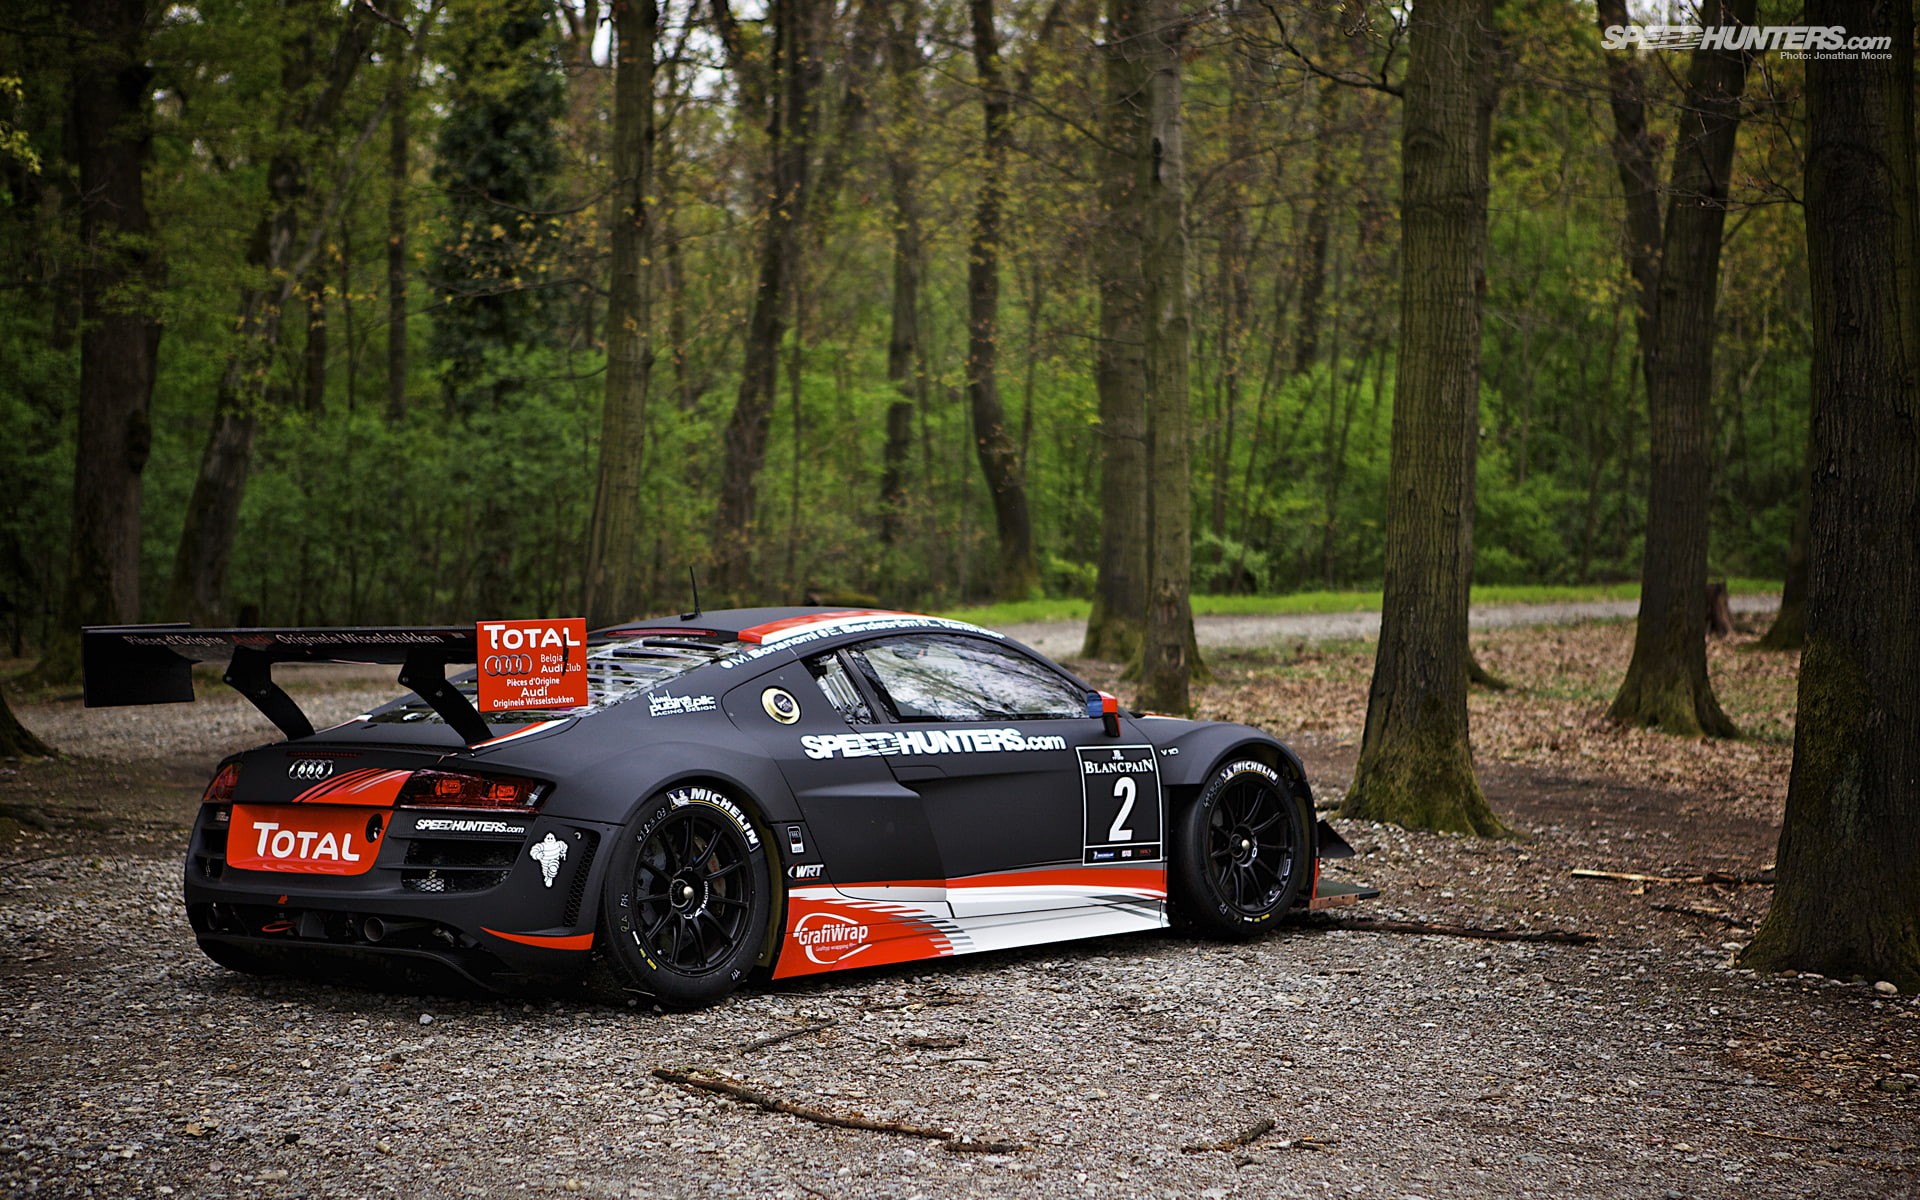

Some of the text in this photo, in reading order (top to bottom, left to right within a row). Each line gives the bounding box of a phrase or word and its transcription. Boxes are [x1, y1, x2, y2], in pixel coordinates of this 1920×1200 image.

[231, 634, 274, 645] Audi
[483, 624, 580, 649] TOTAL
[540, 654, 563, 664] Belgia
[541, 664, 563, 673] Audi
[506, 677, 560, 688] Pièces d'Origine
[521, 687, 548, 697] Audi
[493, 695, 575, 709] Originele Wisselstukken
[801, 728, 1066, 759] SPEEDHUNTERS.com
[1083, 758, 1154, 774] BLANCPAIN
[1233, 761, 1278, 781] MICHELIN
[1109, 776, 1136, 841] 2
[690, 788, 759, 845] MICHELIN
[415, 819, 525, 834] SPEEDHUNTERS.com
[253, 821, 360, 861] TOTAL
[796, 864, 825, 878] WRT
[798, 923, 869, 946] GrafiWrap
